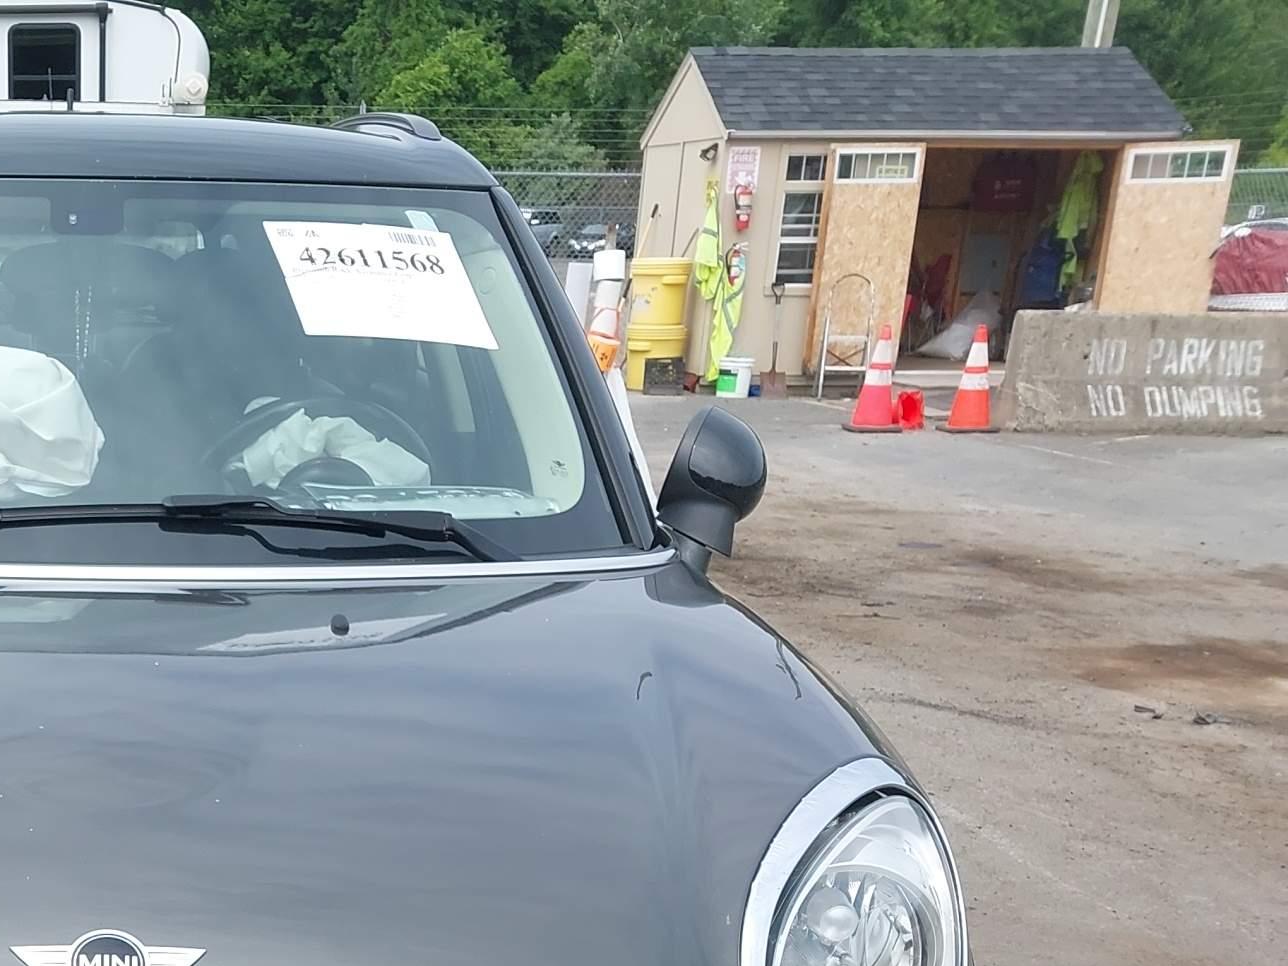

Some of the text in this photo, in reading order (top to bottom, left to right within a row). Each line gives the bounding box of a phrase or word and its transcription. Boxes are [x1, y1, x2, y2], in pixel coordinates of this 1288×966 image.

[299, 247, 445, 275] 42611568
[1087, 337, 1264, 377] NO PARKING
[1087, 384, 1265, 420] NO DUMPING
